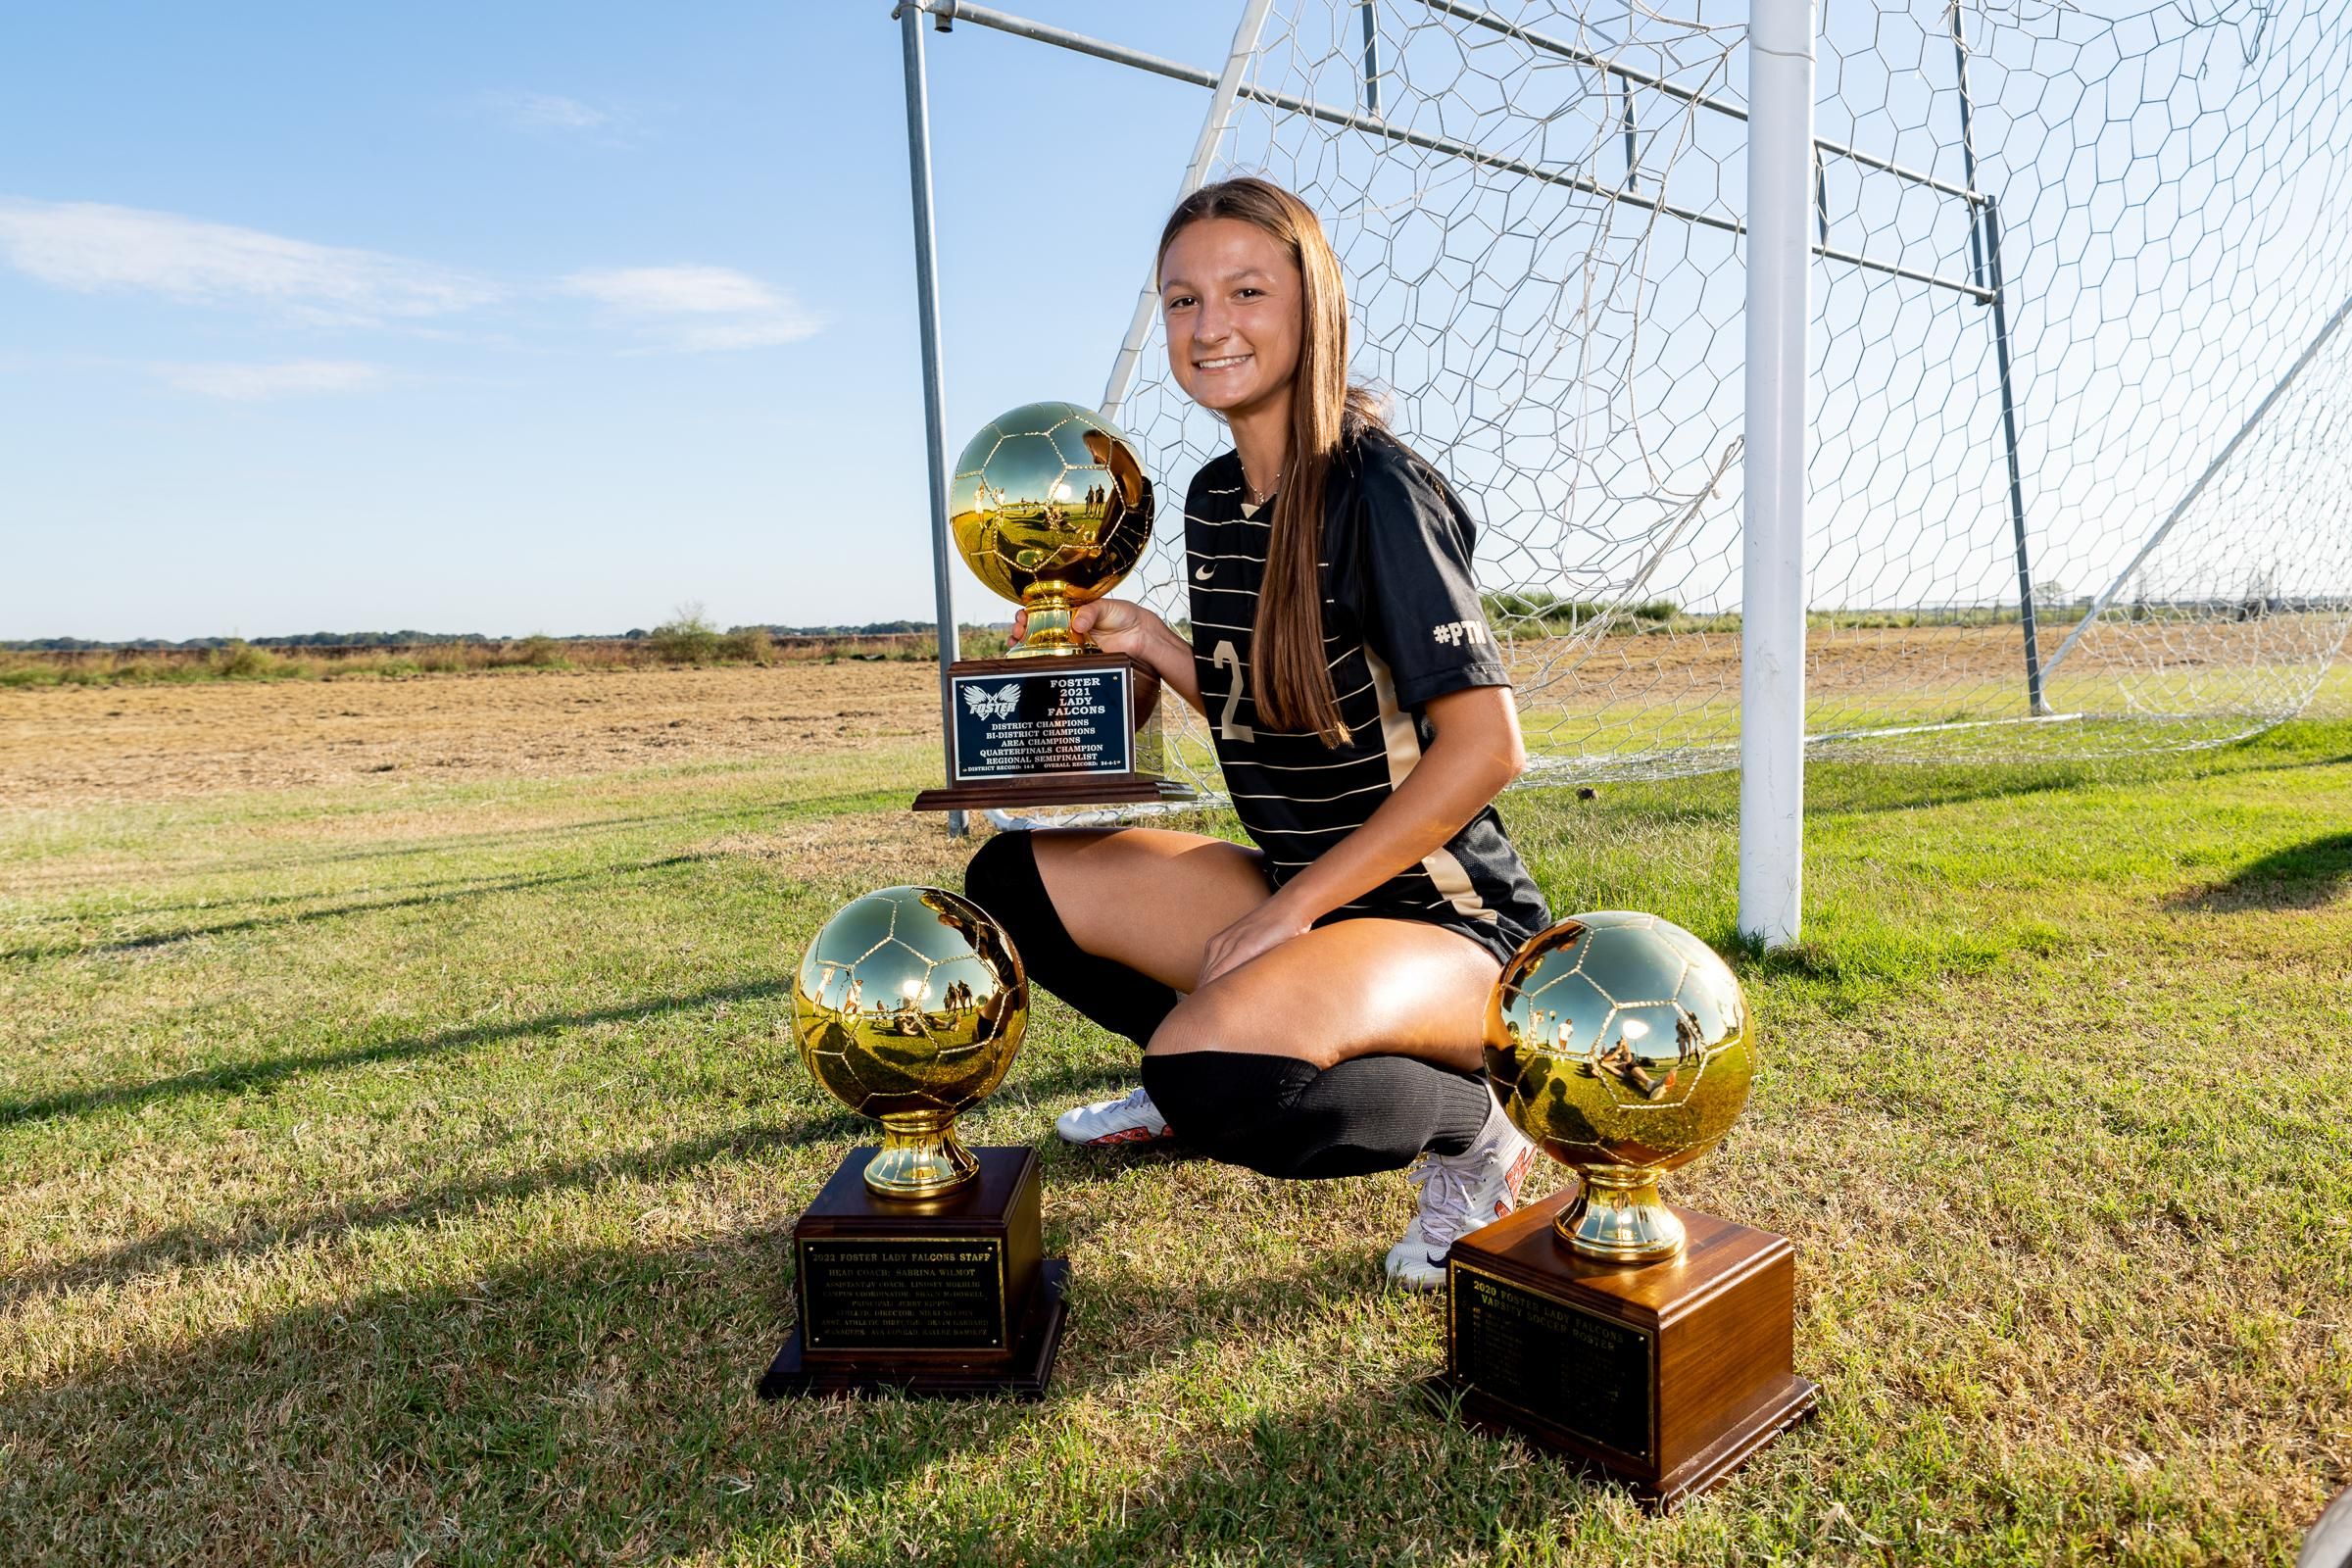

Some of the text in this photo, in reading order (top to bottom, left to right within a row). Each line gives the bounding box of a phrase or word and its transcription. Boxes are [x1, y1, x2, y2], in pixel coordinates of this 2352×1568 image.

[1050, 677, 1101, 688] FOSTER
[1059, 688, 1091, 697] 2021
[1213, 640, 1254, 743] 2
[969, 702, 1017, 714] FOSTER
[1059, 697, 1094, 707] LADY
[1048, 706, 1105, 716] FALCONS
[992, 719, 1090, 731] DISTRICT CHAMPIONS
[986, 727, 1096, 740] BI-DISTRICT CHAMPIONS
[1001, 736, 1081, 748] AREA CHAMPIONS
[980, 744, 1103, 758] QUARTERFINALS CHAMPION
[986, 753, 1098, 765] REGIONAL SEMIFINALIST
[812, 1253, 991, 1262] 2022 FOSTER LADY FALCONS STAFF
[1473, 1280, 1624, 1345] 2020 FOSTER LADY FALCONS
[1481, 1295, 1615, 1351] VARSITY SOCCER ROSTER
